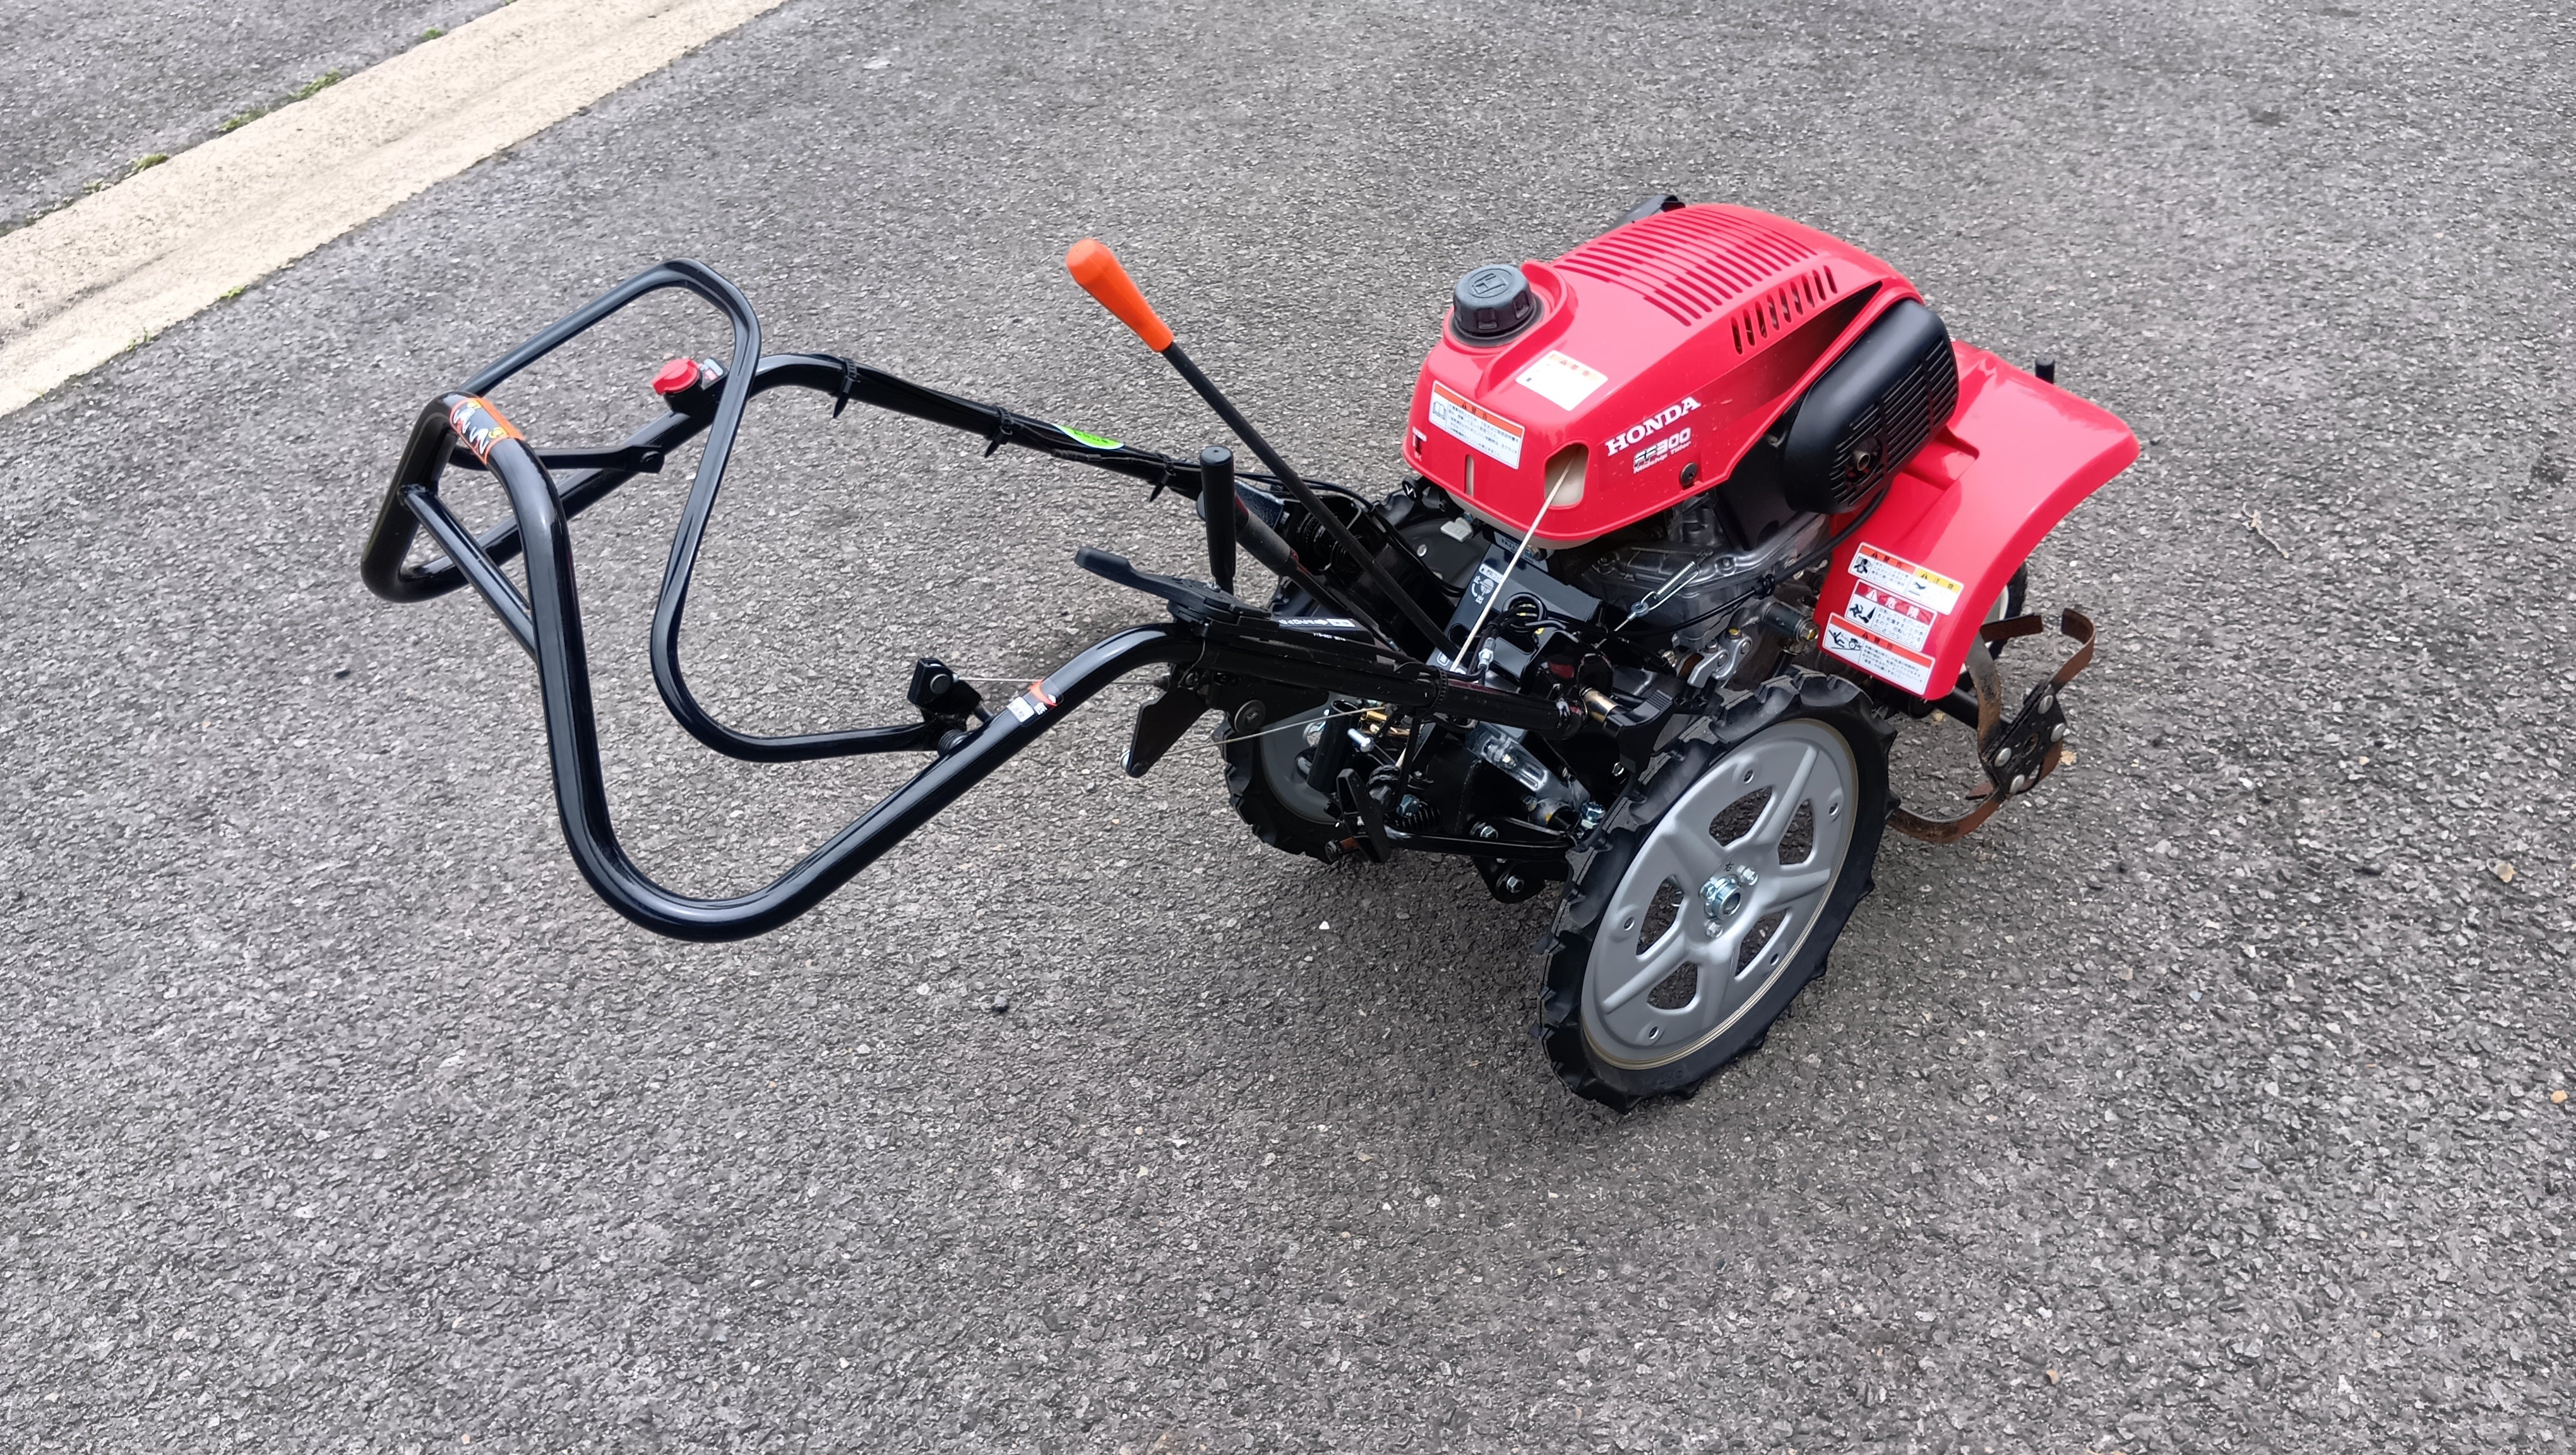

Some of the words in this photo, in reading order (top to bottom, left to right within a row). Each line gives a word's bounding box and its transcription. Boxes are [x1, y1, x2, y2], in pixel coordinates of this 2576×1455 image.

[1605, 397, 1702, 457] HONDA
[1633, 428, 1691, 467] FF300
[1885, 597, 1920, 619] 危険
[1723, 861, 1734, 871] 右
